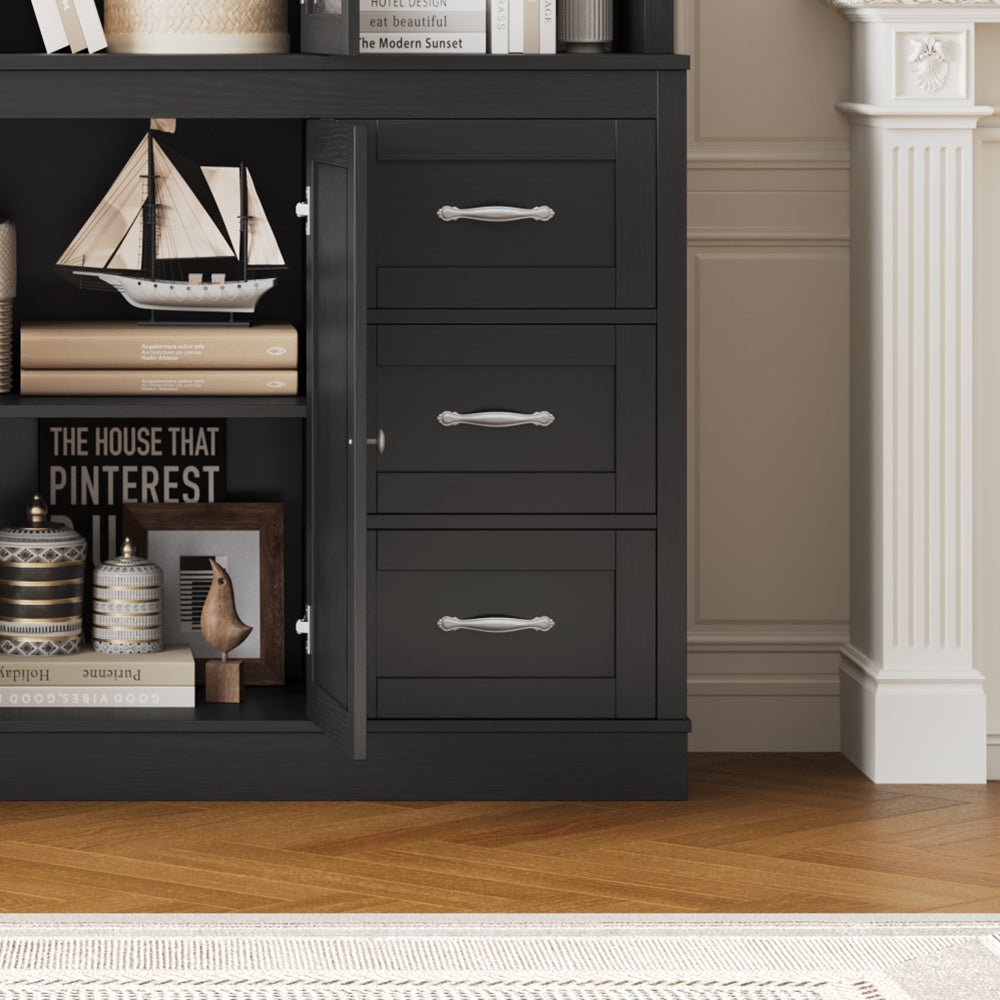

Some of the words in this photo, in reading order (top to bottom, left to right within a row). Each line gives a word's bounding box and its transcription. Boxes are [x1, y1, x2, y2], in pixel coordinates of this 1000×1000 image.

[369, 17, 389, 28] eat
[392, 15, 448, 28] beautiful
[379, 38, 422, 49] Modern
[425, 38, 463, 49] Sunset
[50, 427, 89, 456] THE
[95, 427, 163, 456] HOUSE
[168, 427, 220, 456] THAT
[50, 465, 220, 506] PINTEREST
[82, 668, 141, 682] Purienne
[9, 692, 56, 704] GOOD
[58, 692, 108, 704] VIBES,
[114, 692, 161, 704] GOOD
